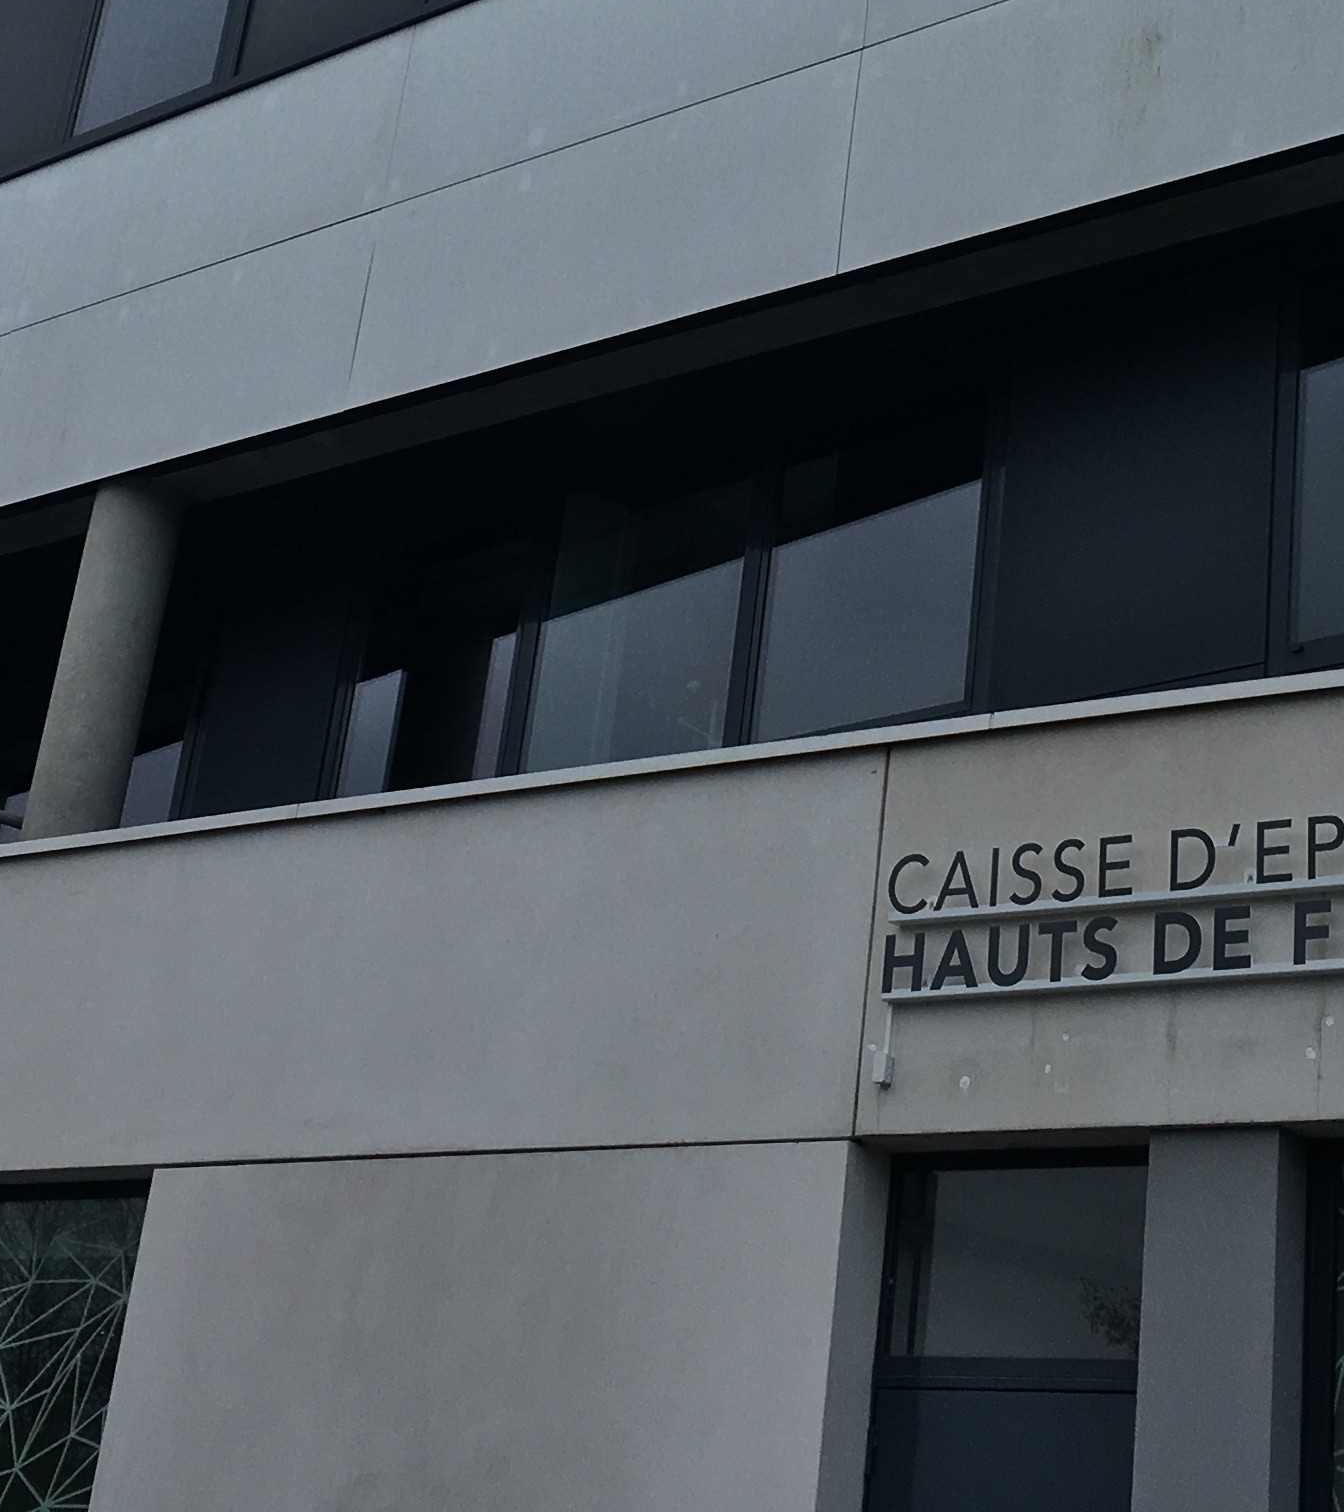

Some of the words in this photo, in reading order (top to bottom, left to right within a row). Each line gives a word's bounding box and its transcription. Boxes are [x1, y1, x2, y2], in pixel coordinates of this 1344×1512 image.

[887, 834, 1134, 915] CAISSE
[881, 915, 1120, 994] HAUTS
[1152, 905, 1253, 976] DE
